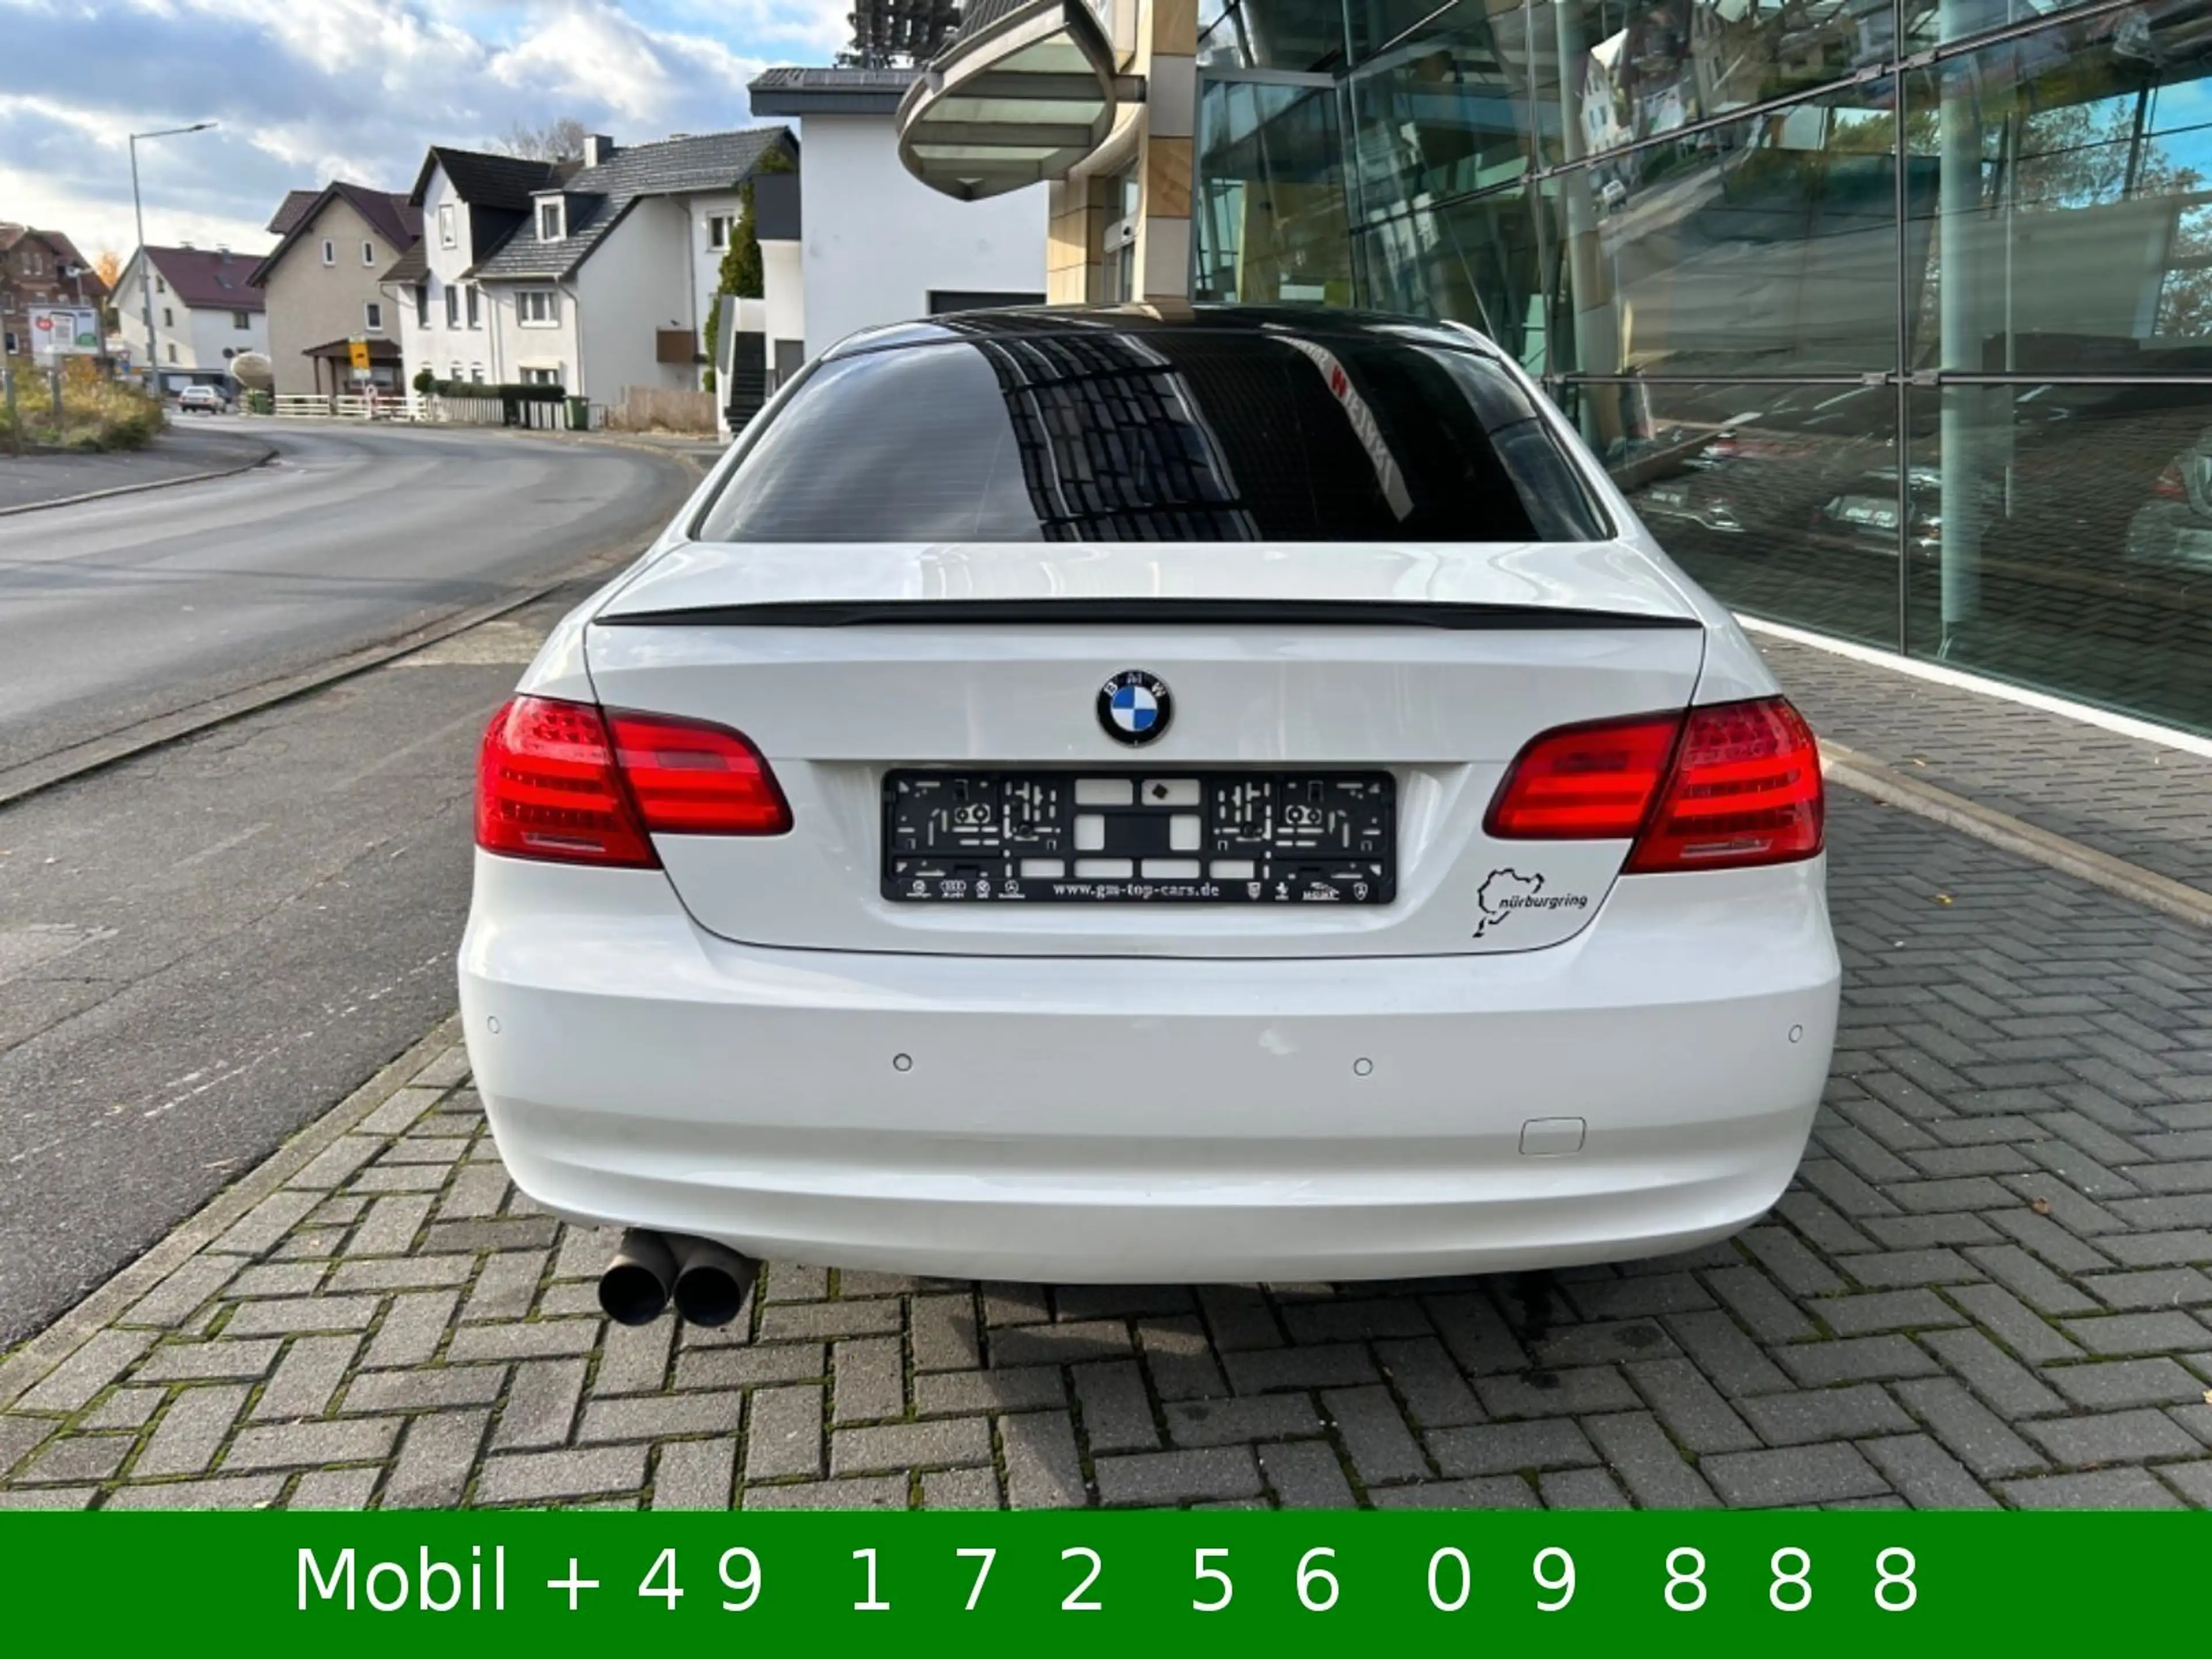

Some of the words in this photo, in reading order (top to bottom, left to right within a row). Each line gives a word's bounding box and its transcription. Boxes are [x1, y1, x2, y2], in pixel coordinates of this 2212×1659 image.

[1104, 672, 1167, 697] BMW
[1052, 882, 1220, 899] www.gm-top-cars.de
[1498, 893, 1588, 909] nürburgring
